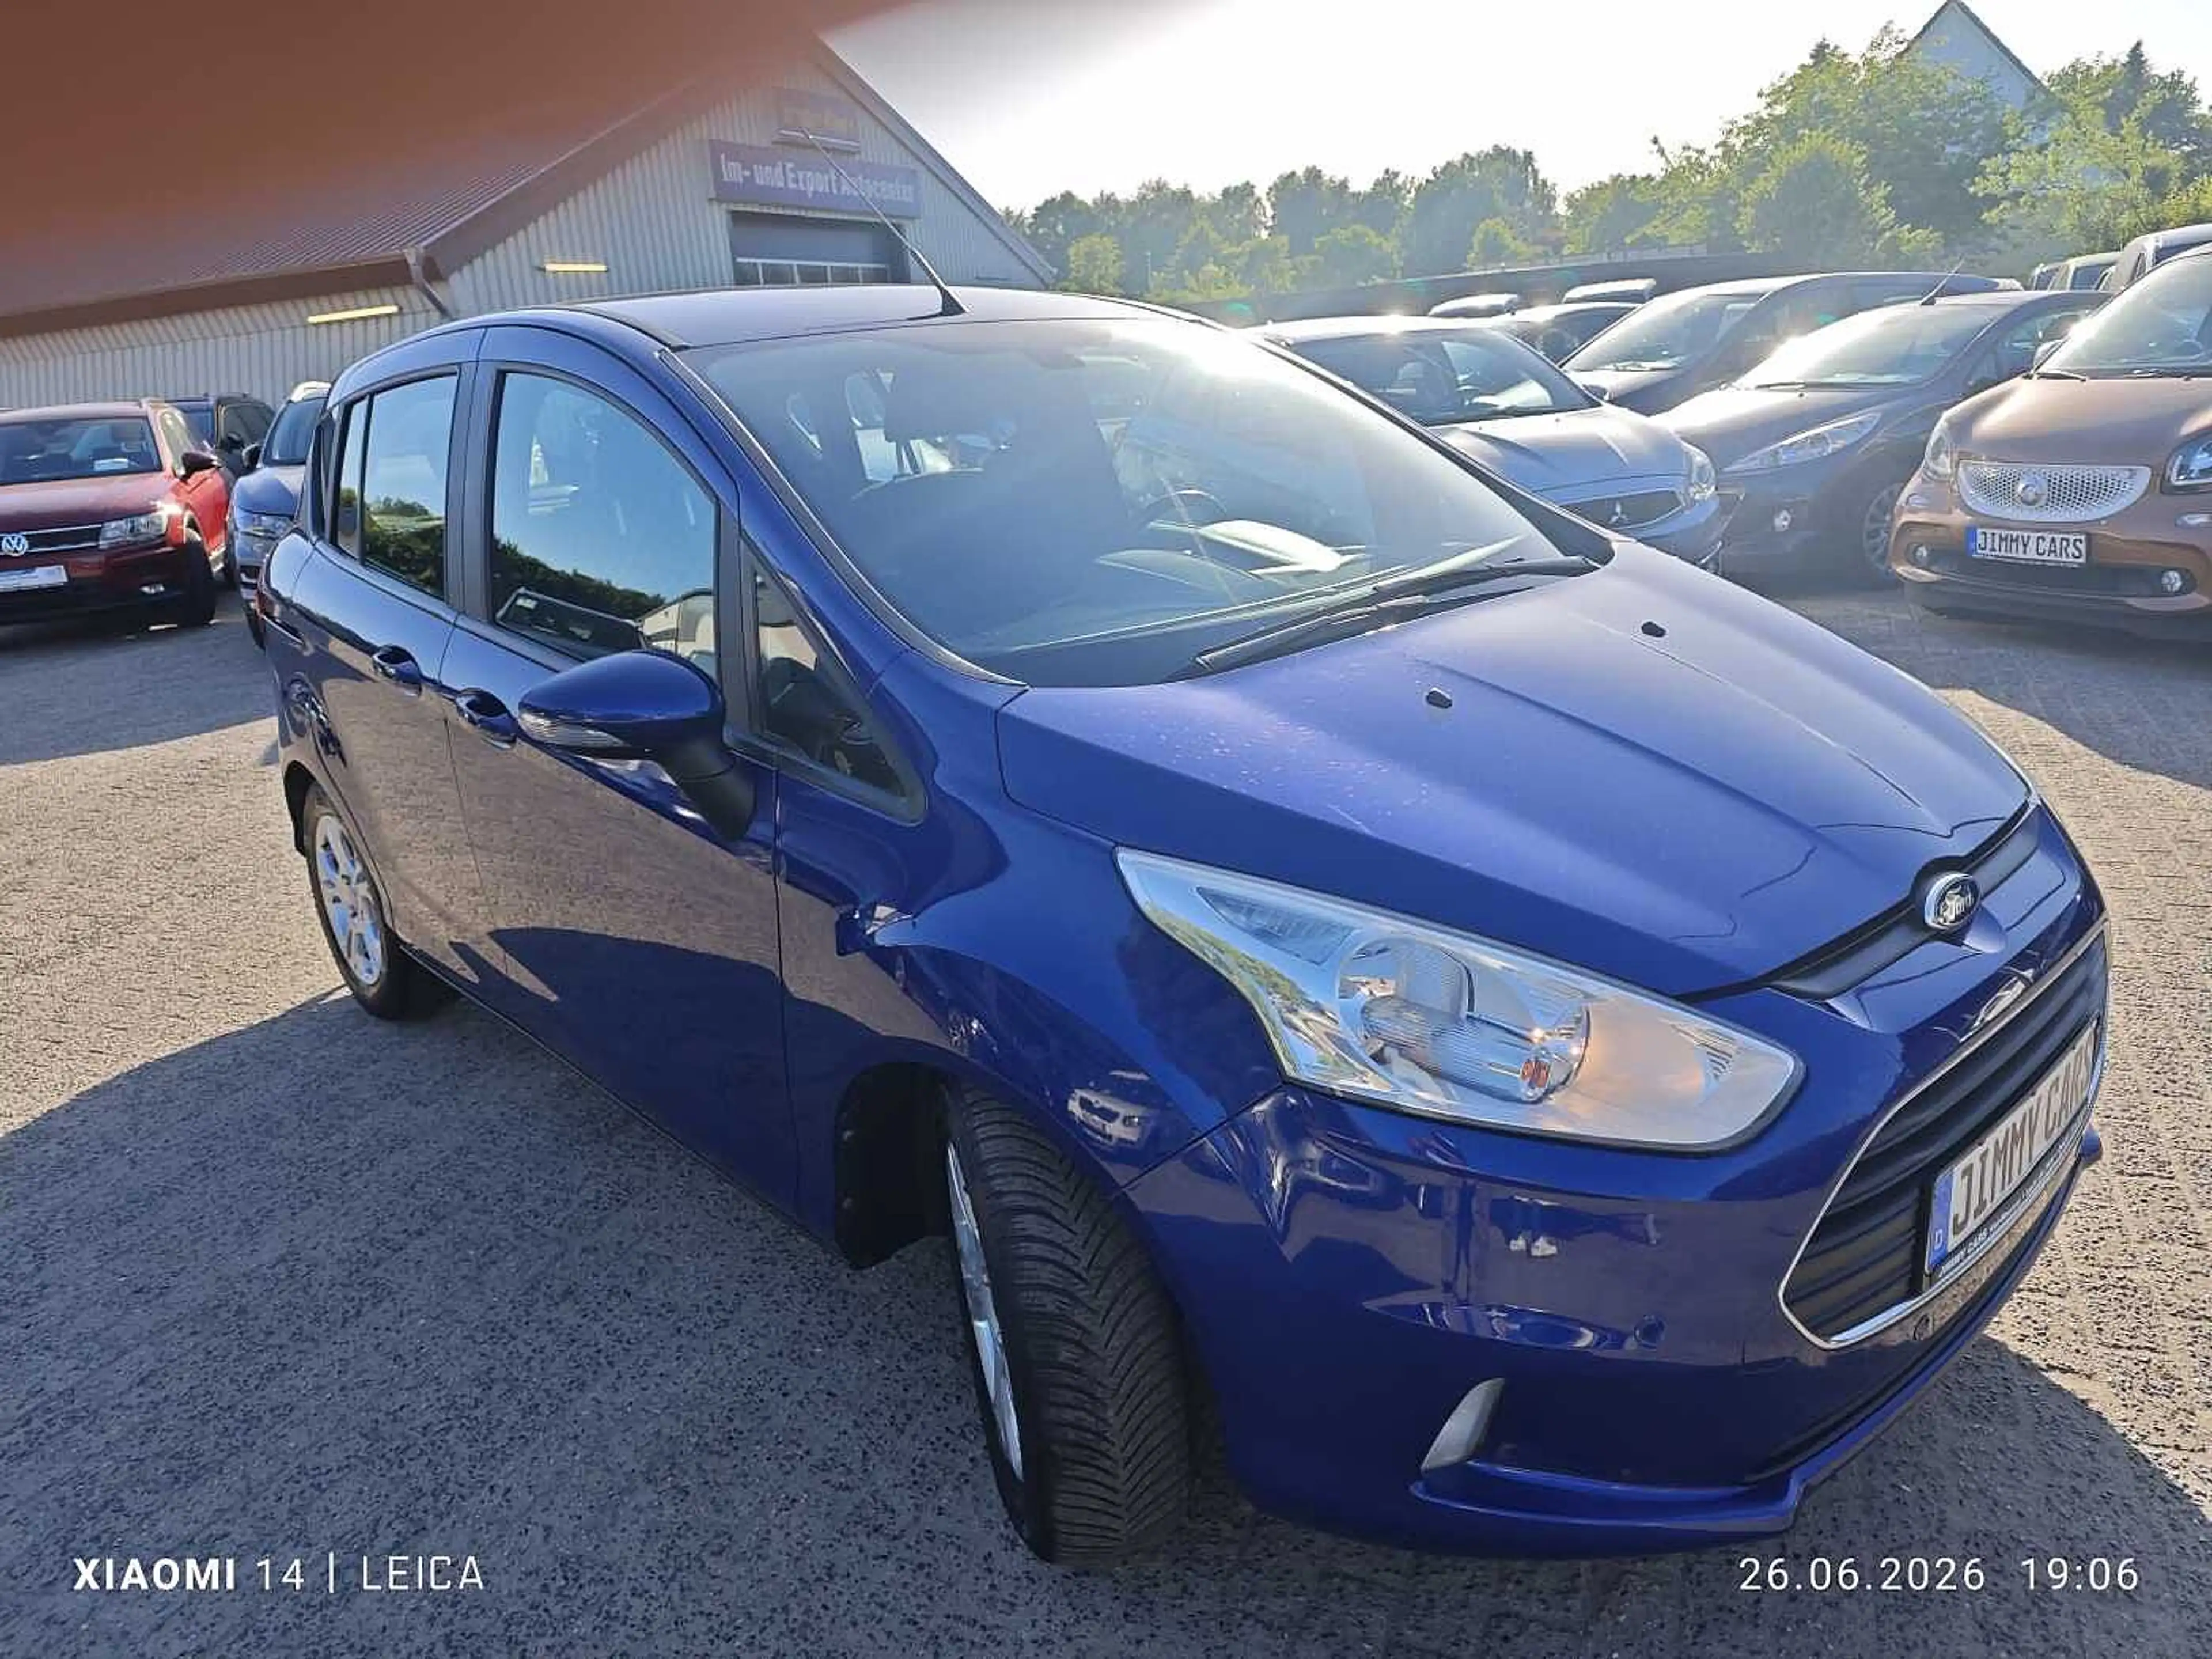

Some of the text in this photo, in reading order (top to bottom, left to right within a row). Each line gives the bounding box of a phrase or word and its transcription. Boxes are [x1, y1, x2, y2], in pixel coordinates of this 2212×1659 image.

[721, 153, 751, 187] Im-
[752, 161, 785, 188] und
[785, 162, 836, 198] Export
[1978, 531, 2083, 559] JIMMY CARS
[1953, 1096, 2043, 1236] JIMMY
[2045, 1031, 2092, 1141] CARS
[1934, 1228, 1944, 1251] D
